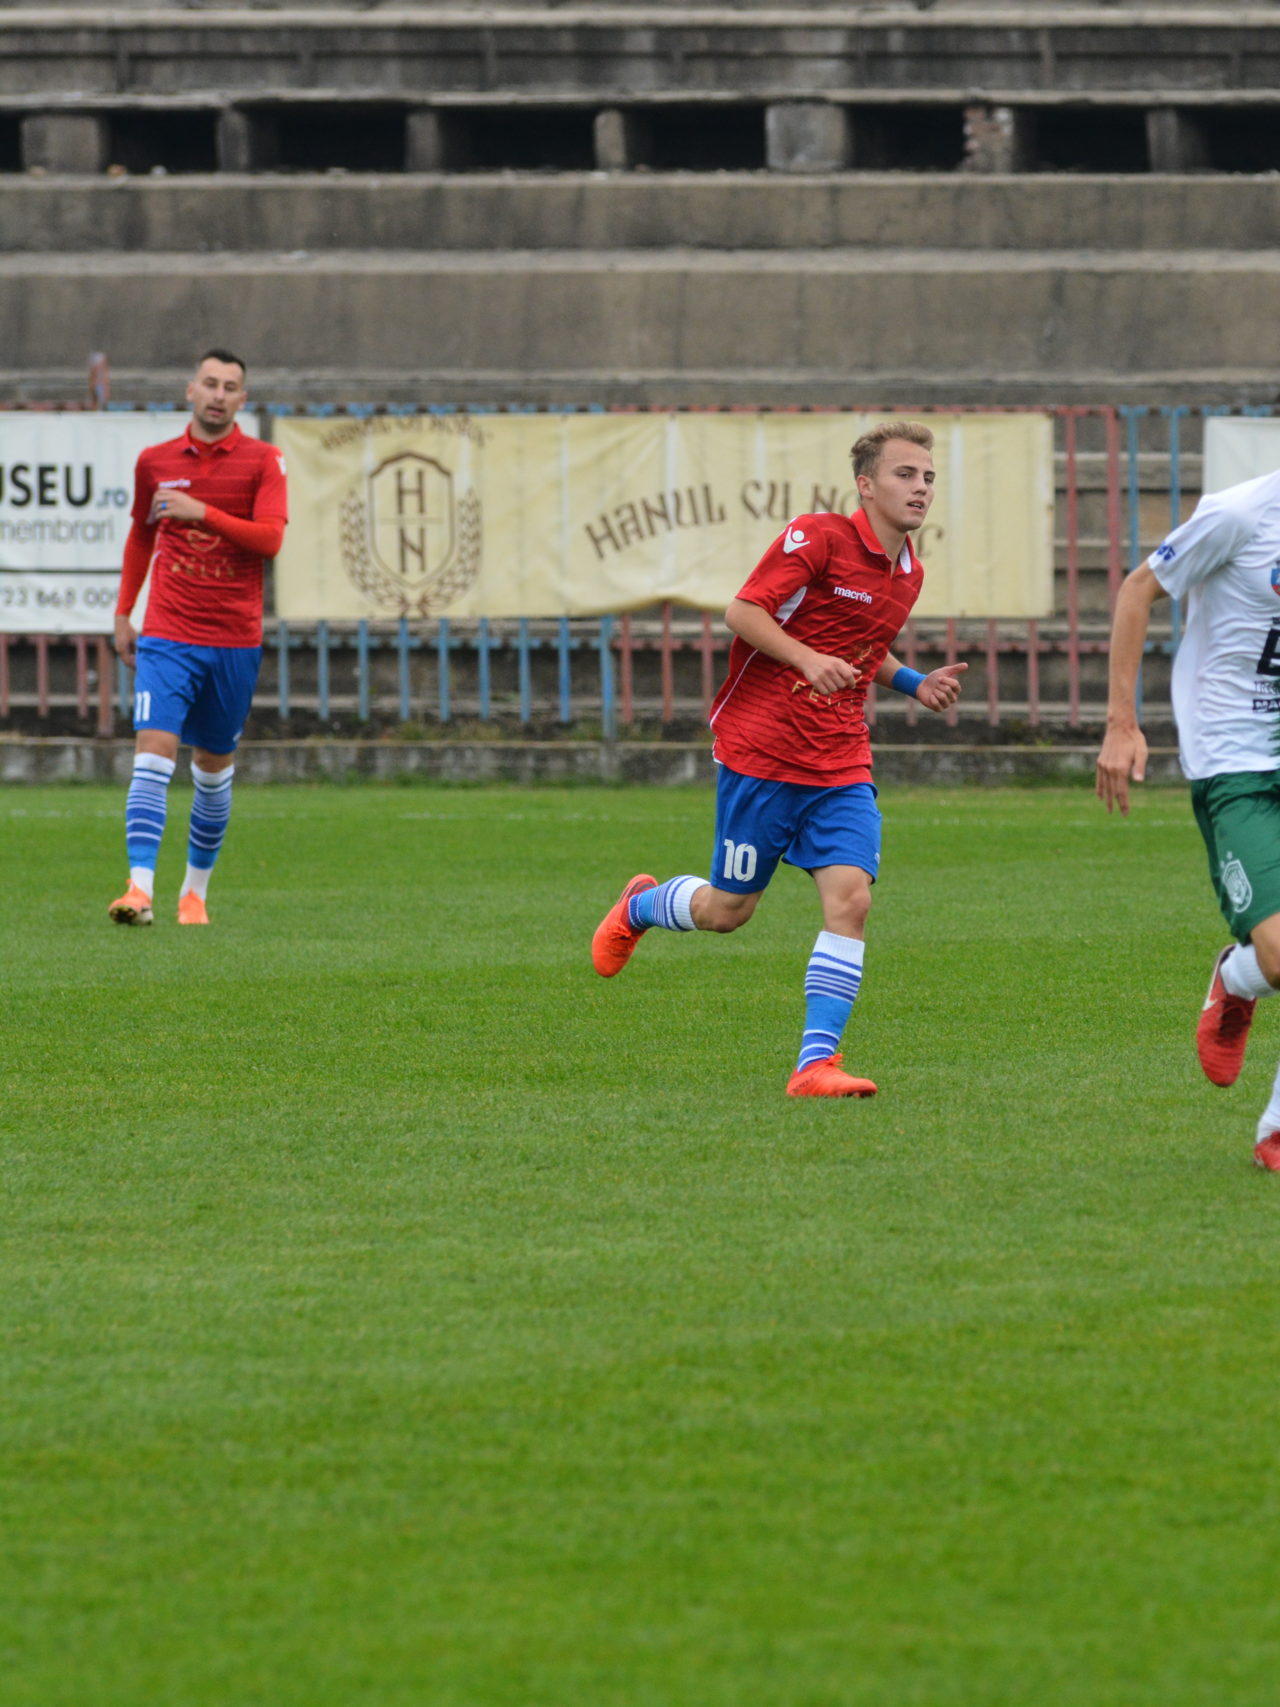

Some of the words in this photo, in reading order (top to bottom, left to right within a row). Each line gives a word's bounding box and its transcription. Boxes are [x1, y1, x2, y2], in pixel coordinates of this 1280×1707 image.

[0, 463, 128, 508] SEU.ro
[833, 586, 873, 605] macron
[135, 690, 151, 722] 11
[723, 838, 758, 882] 10
